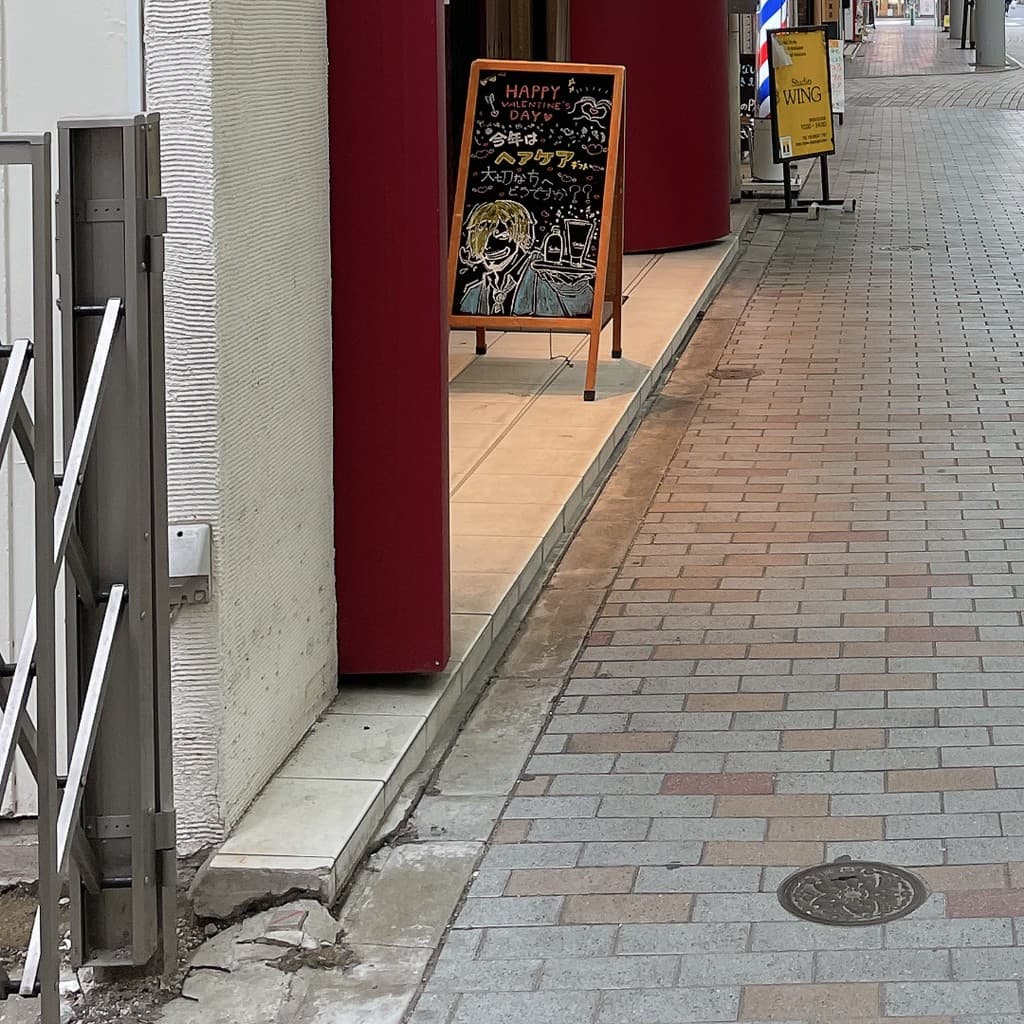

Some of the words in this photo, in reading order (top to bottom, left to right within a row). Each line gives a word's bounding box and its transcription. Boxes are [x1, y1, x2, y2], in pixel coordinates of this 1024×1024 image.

[506, 83, 561, 100] HAPPY
[783, 86, 823, 106] WING
[501, 100, 572, 111] VALENTINE'S
[510, 110, 542, 122] DAY
[489, 130, 538, 147] 今年は
[494, 148, 575, 168] ヘアケア
[480, 165, 554, 187] 大切な方へ
